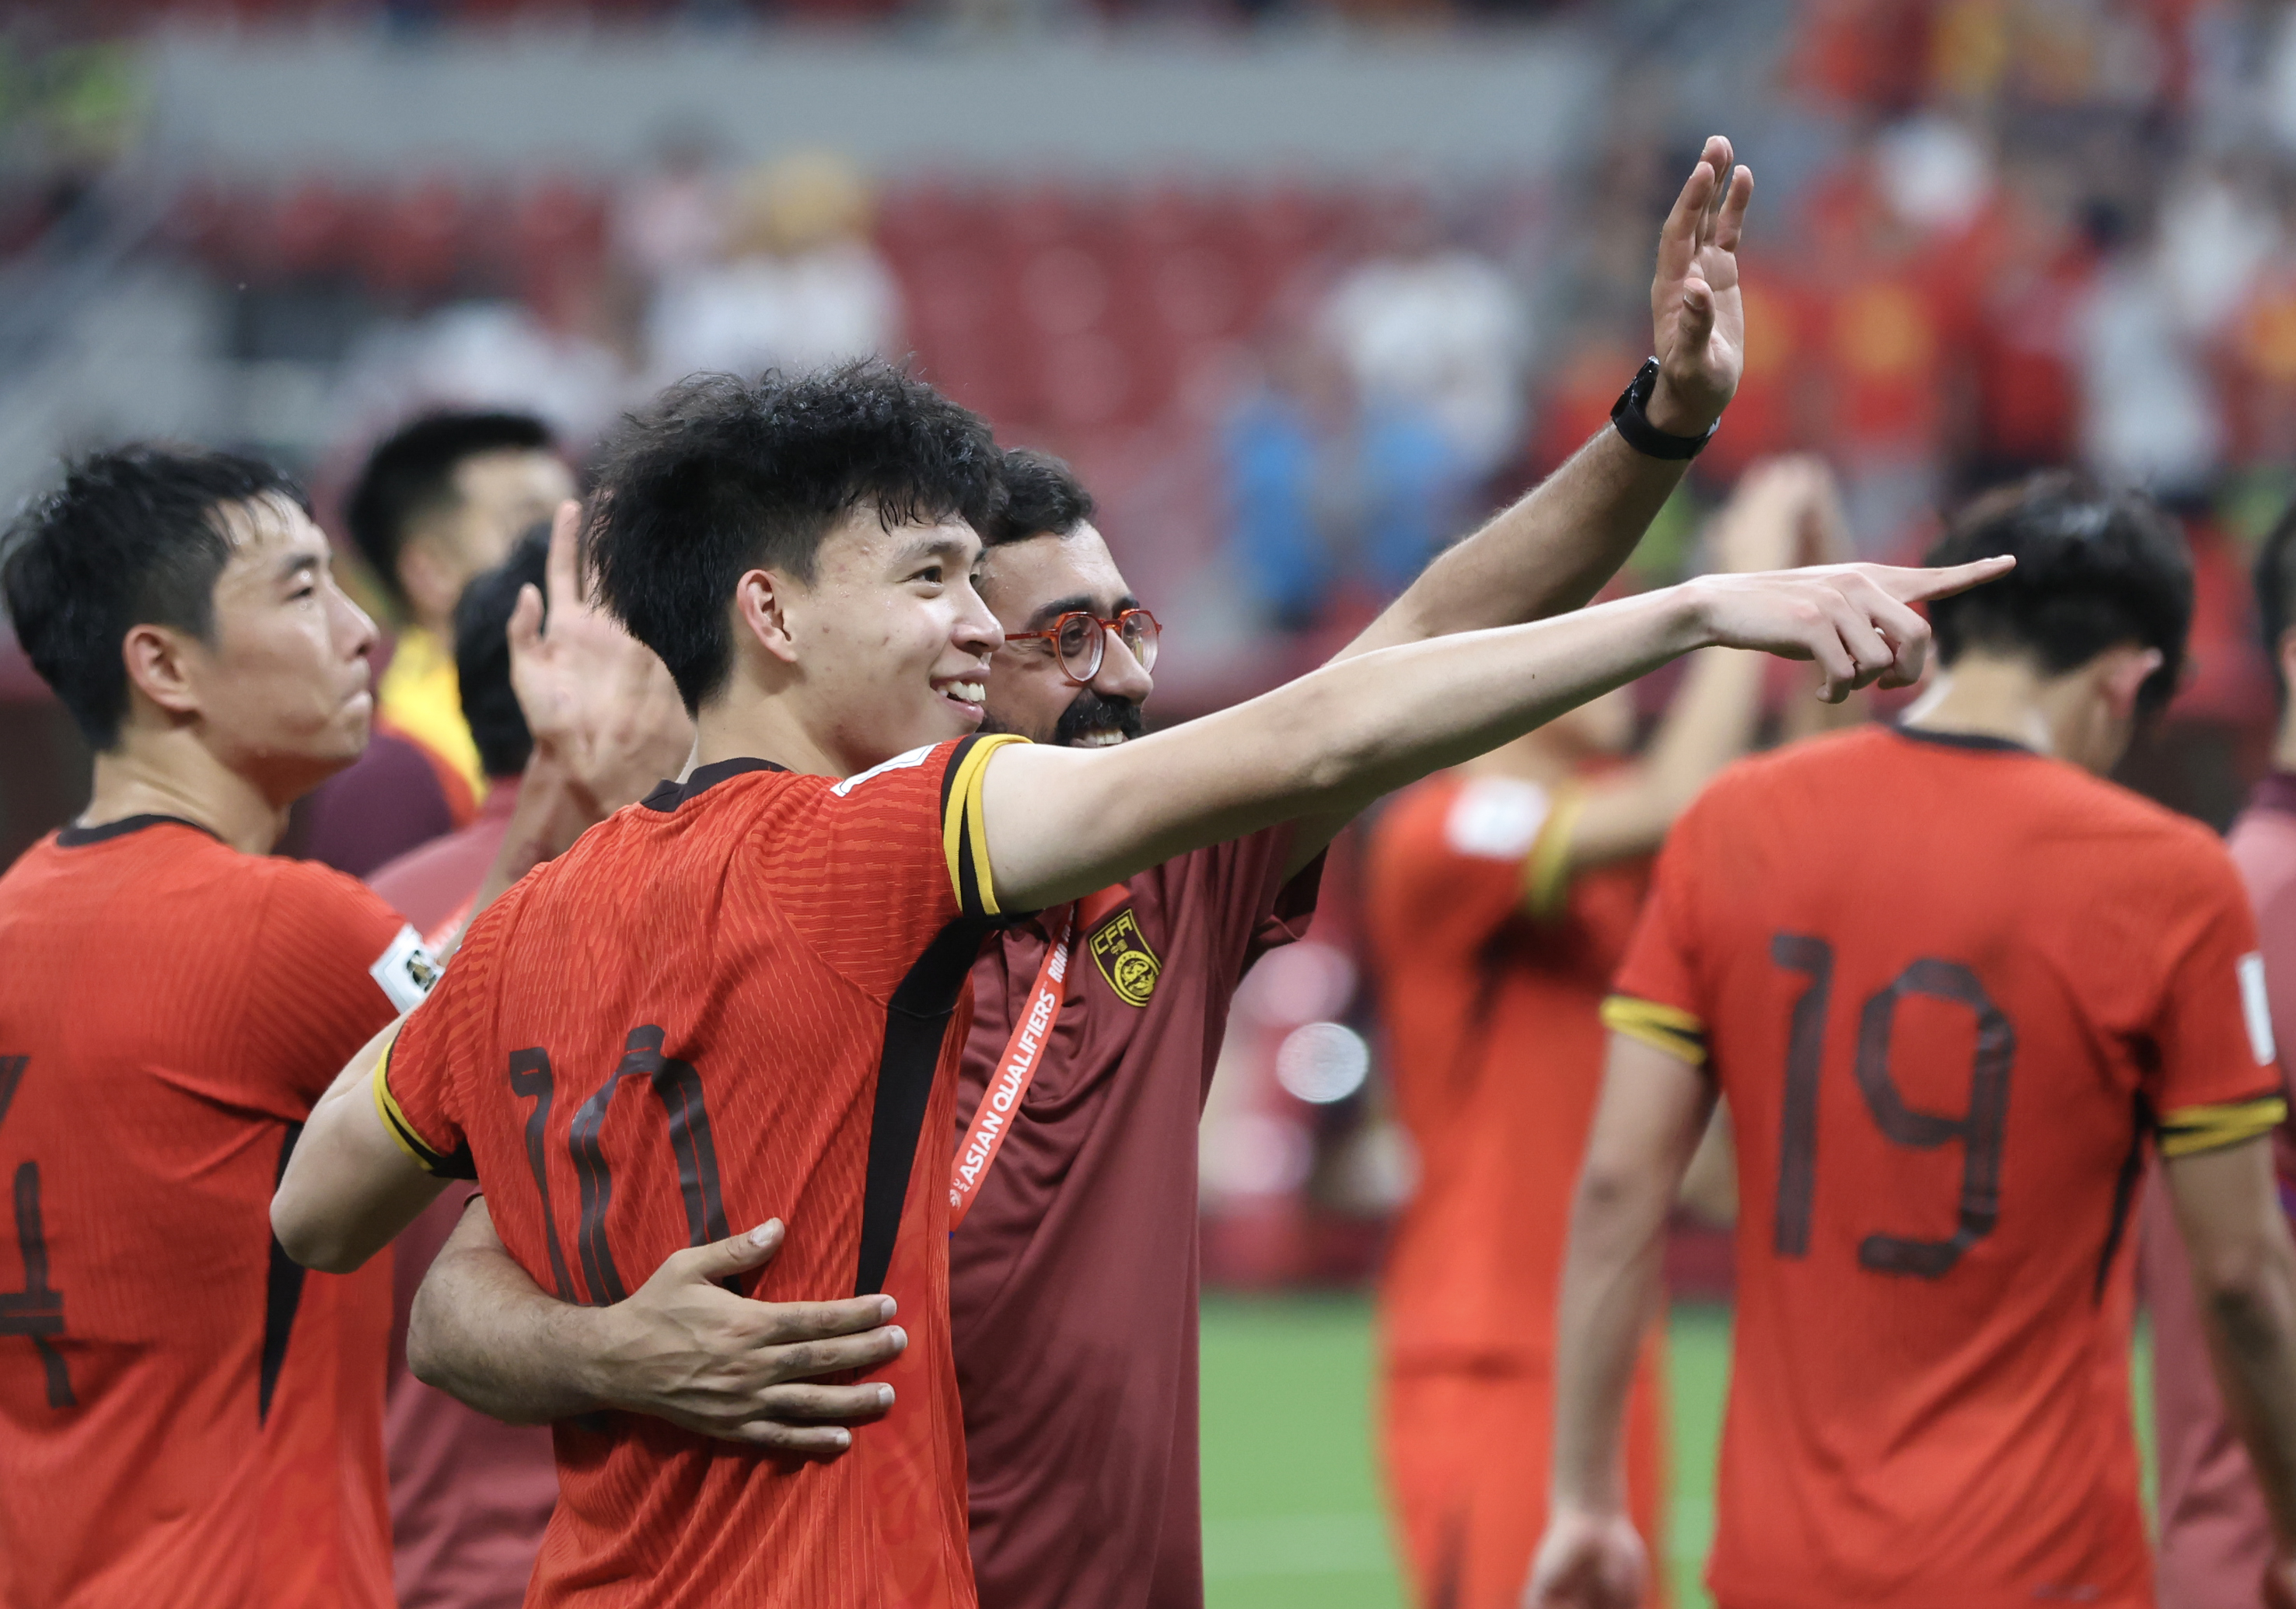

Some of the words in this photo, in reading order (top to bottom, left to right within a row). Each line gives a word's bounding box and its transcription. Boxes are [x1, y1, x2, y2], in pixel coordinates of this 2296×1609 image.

[1094, 916, 1133, 955] CFA
[509, 1024, 743, 1307] 10
[959, 1111, 1004, 1186] ASIAN
[992, 988, 1055, 1112] QUALIFIERS
[1770, 930, 2016, 1280] 19
